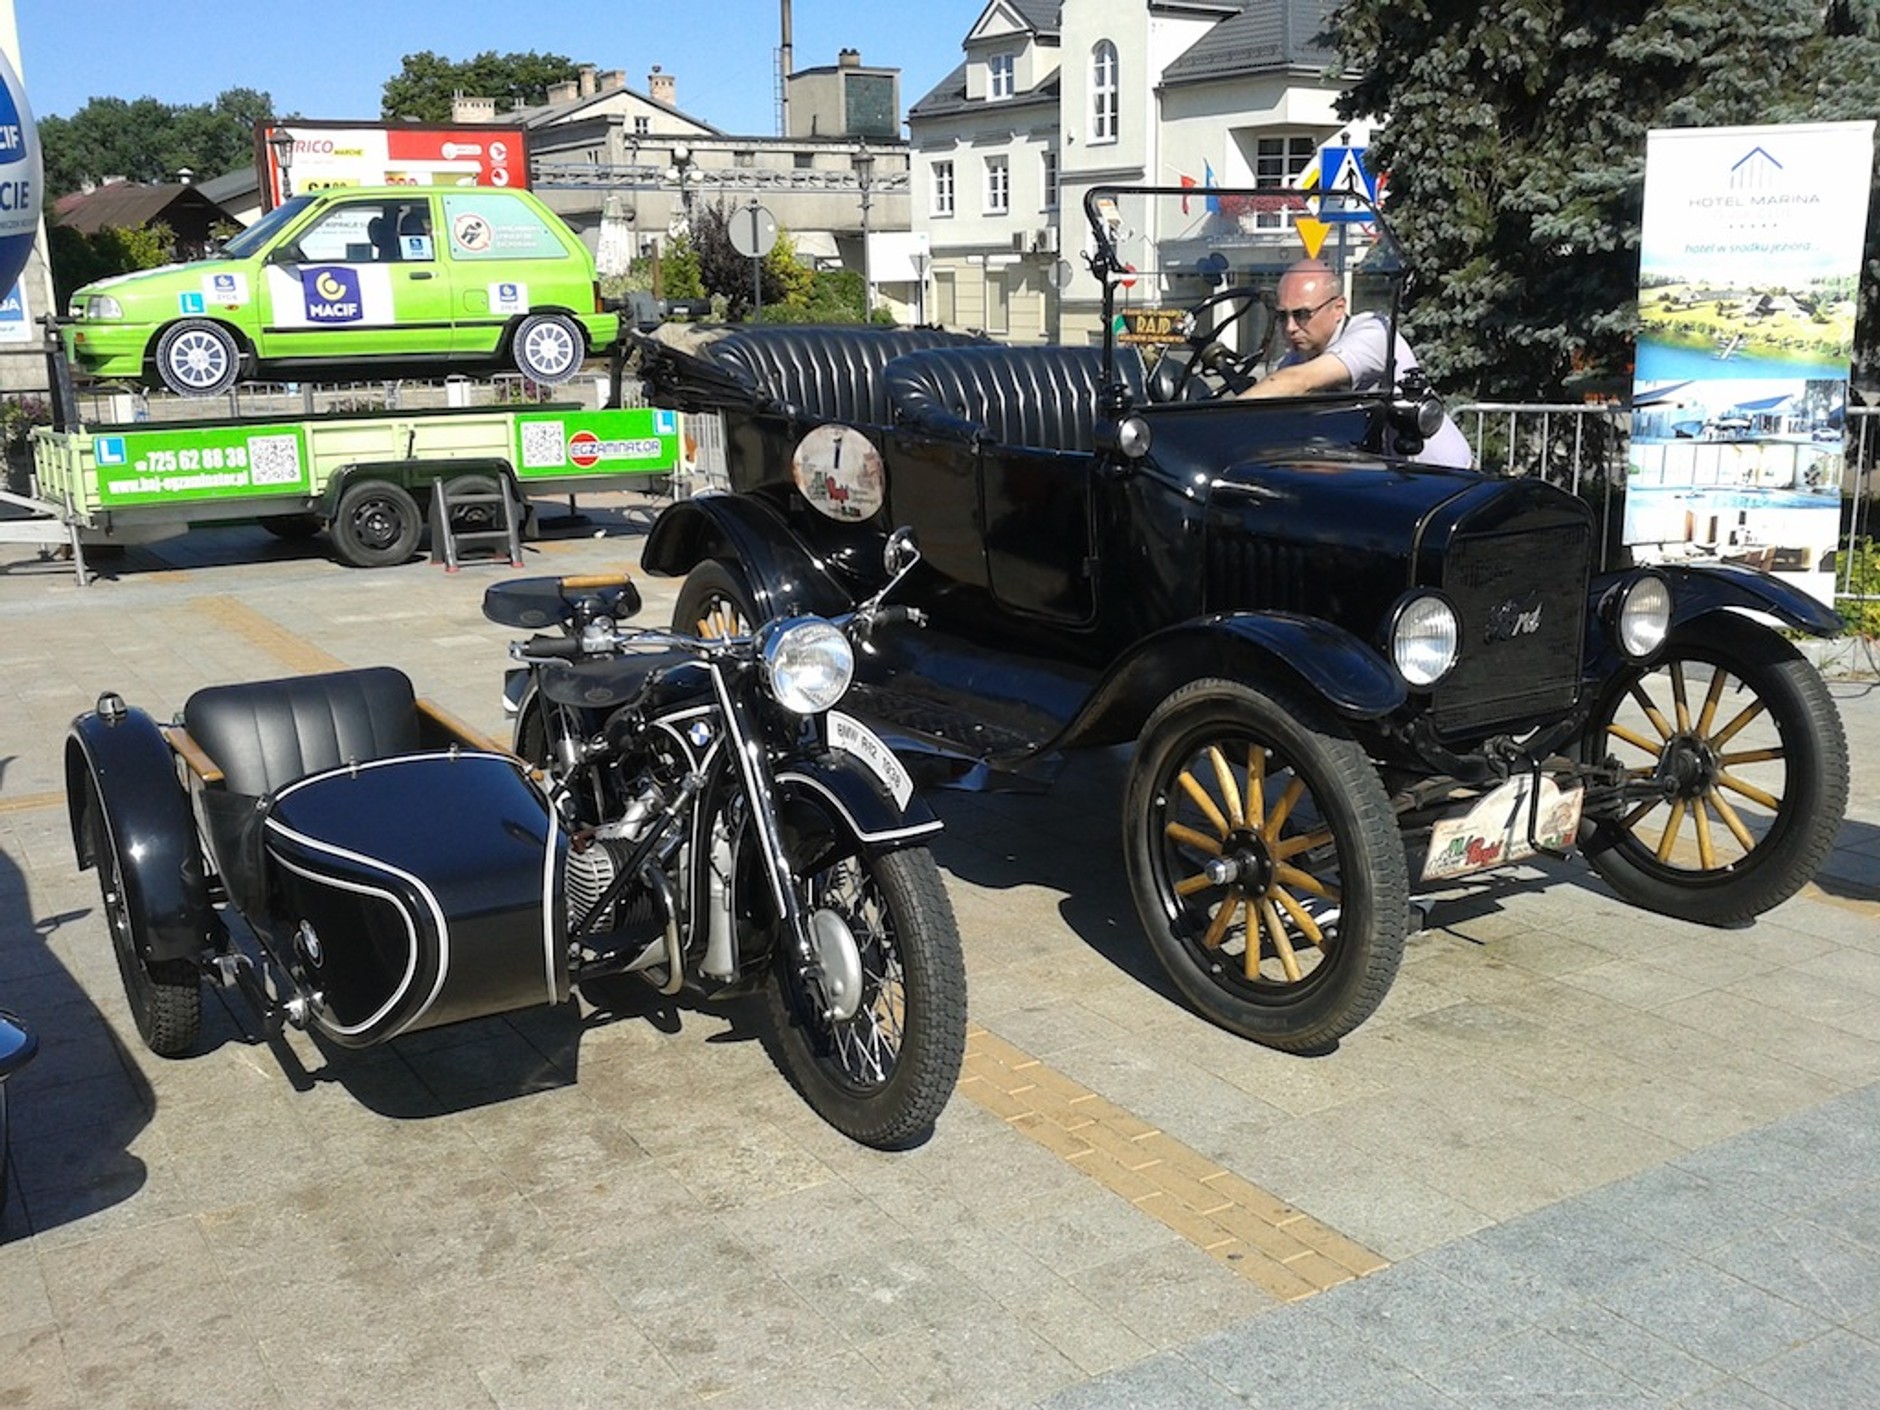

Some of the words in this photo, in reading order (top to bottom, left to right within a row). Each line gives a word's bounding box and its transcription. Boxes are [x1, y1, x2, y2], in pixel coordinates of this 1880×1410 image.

[1689, 197, 1745, 208] HOTEL
[1750, 194, 1821, 206] MARINA
[310, 302, 358, 318] MACIF
[1136, 316, 1171, 336] RAJD
[837, 723, 858, 742] BMW
